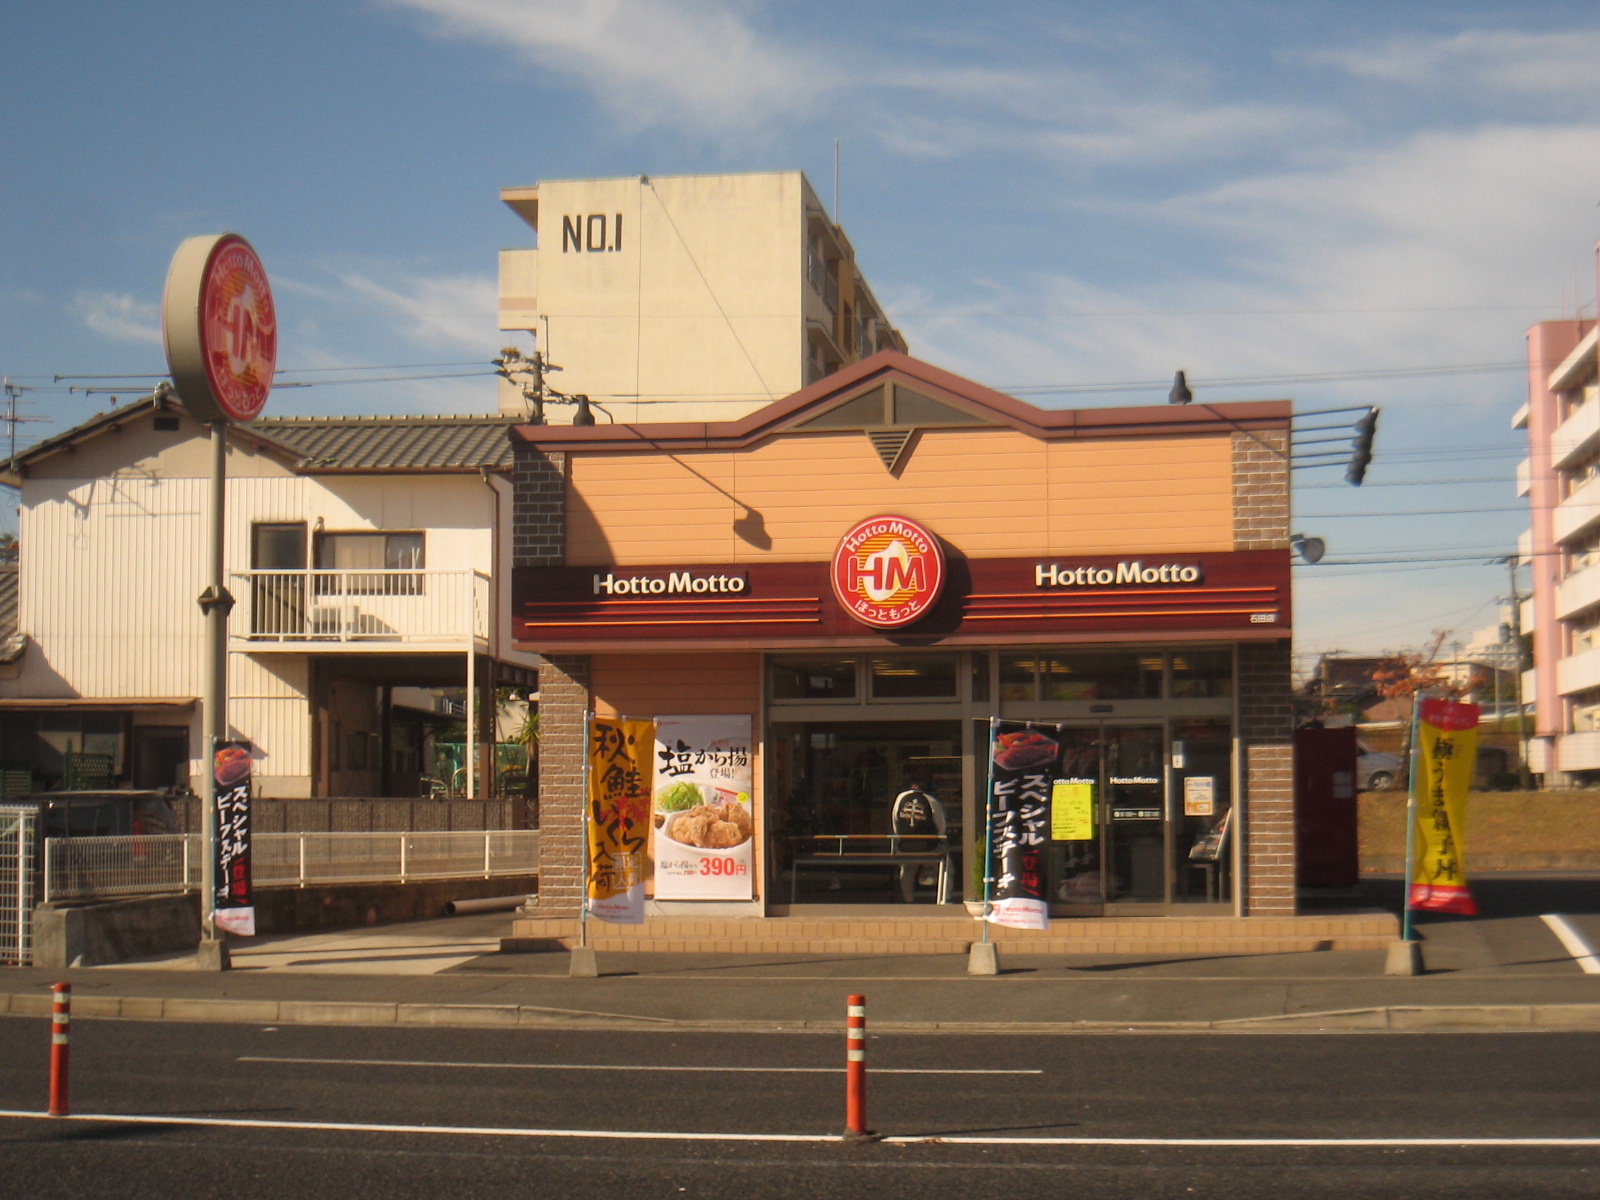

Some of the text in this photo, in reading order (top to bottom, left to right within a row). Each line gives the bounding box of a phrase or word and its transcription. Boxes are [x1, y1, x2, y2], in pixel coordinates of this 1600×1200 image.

[847, 556, 927, 592] HM
[855, 599, 921, 620] ほっともっと
[232, 786, 248, 856] スペシャル
[1018, 774, 1048, 846] スペシャル
[217, 793, 232, 899] ビーフステーキ
[700, 857, 747, 876] 390円
